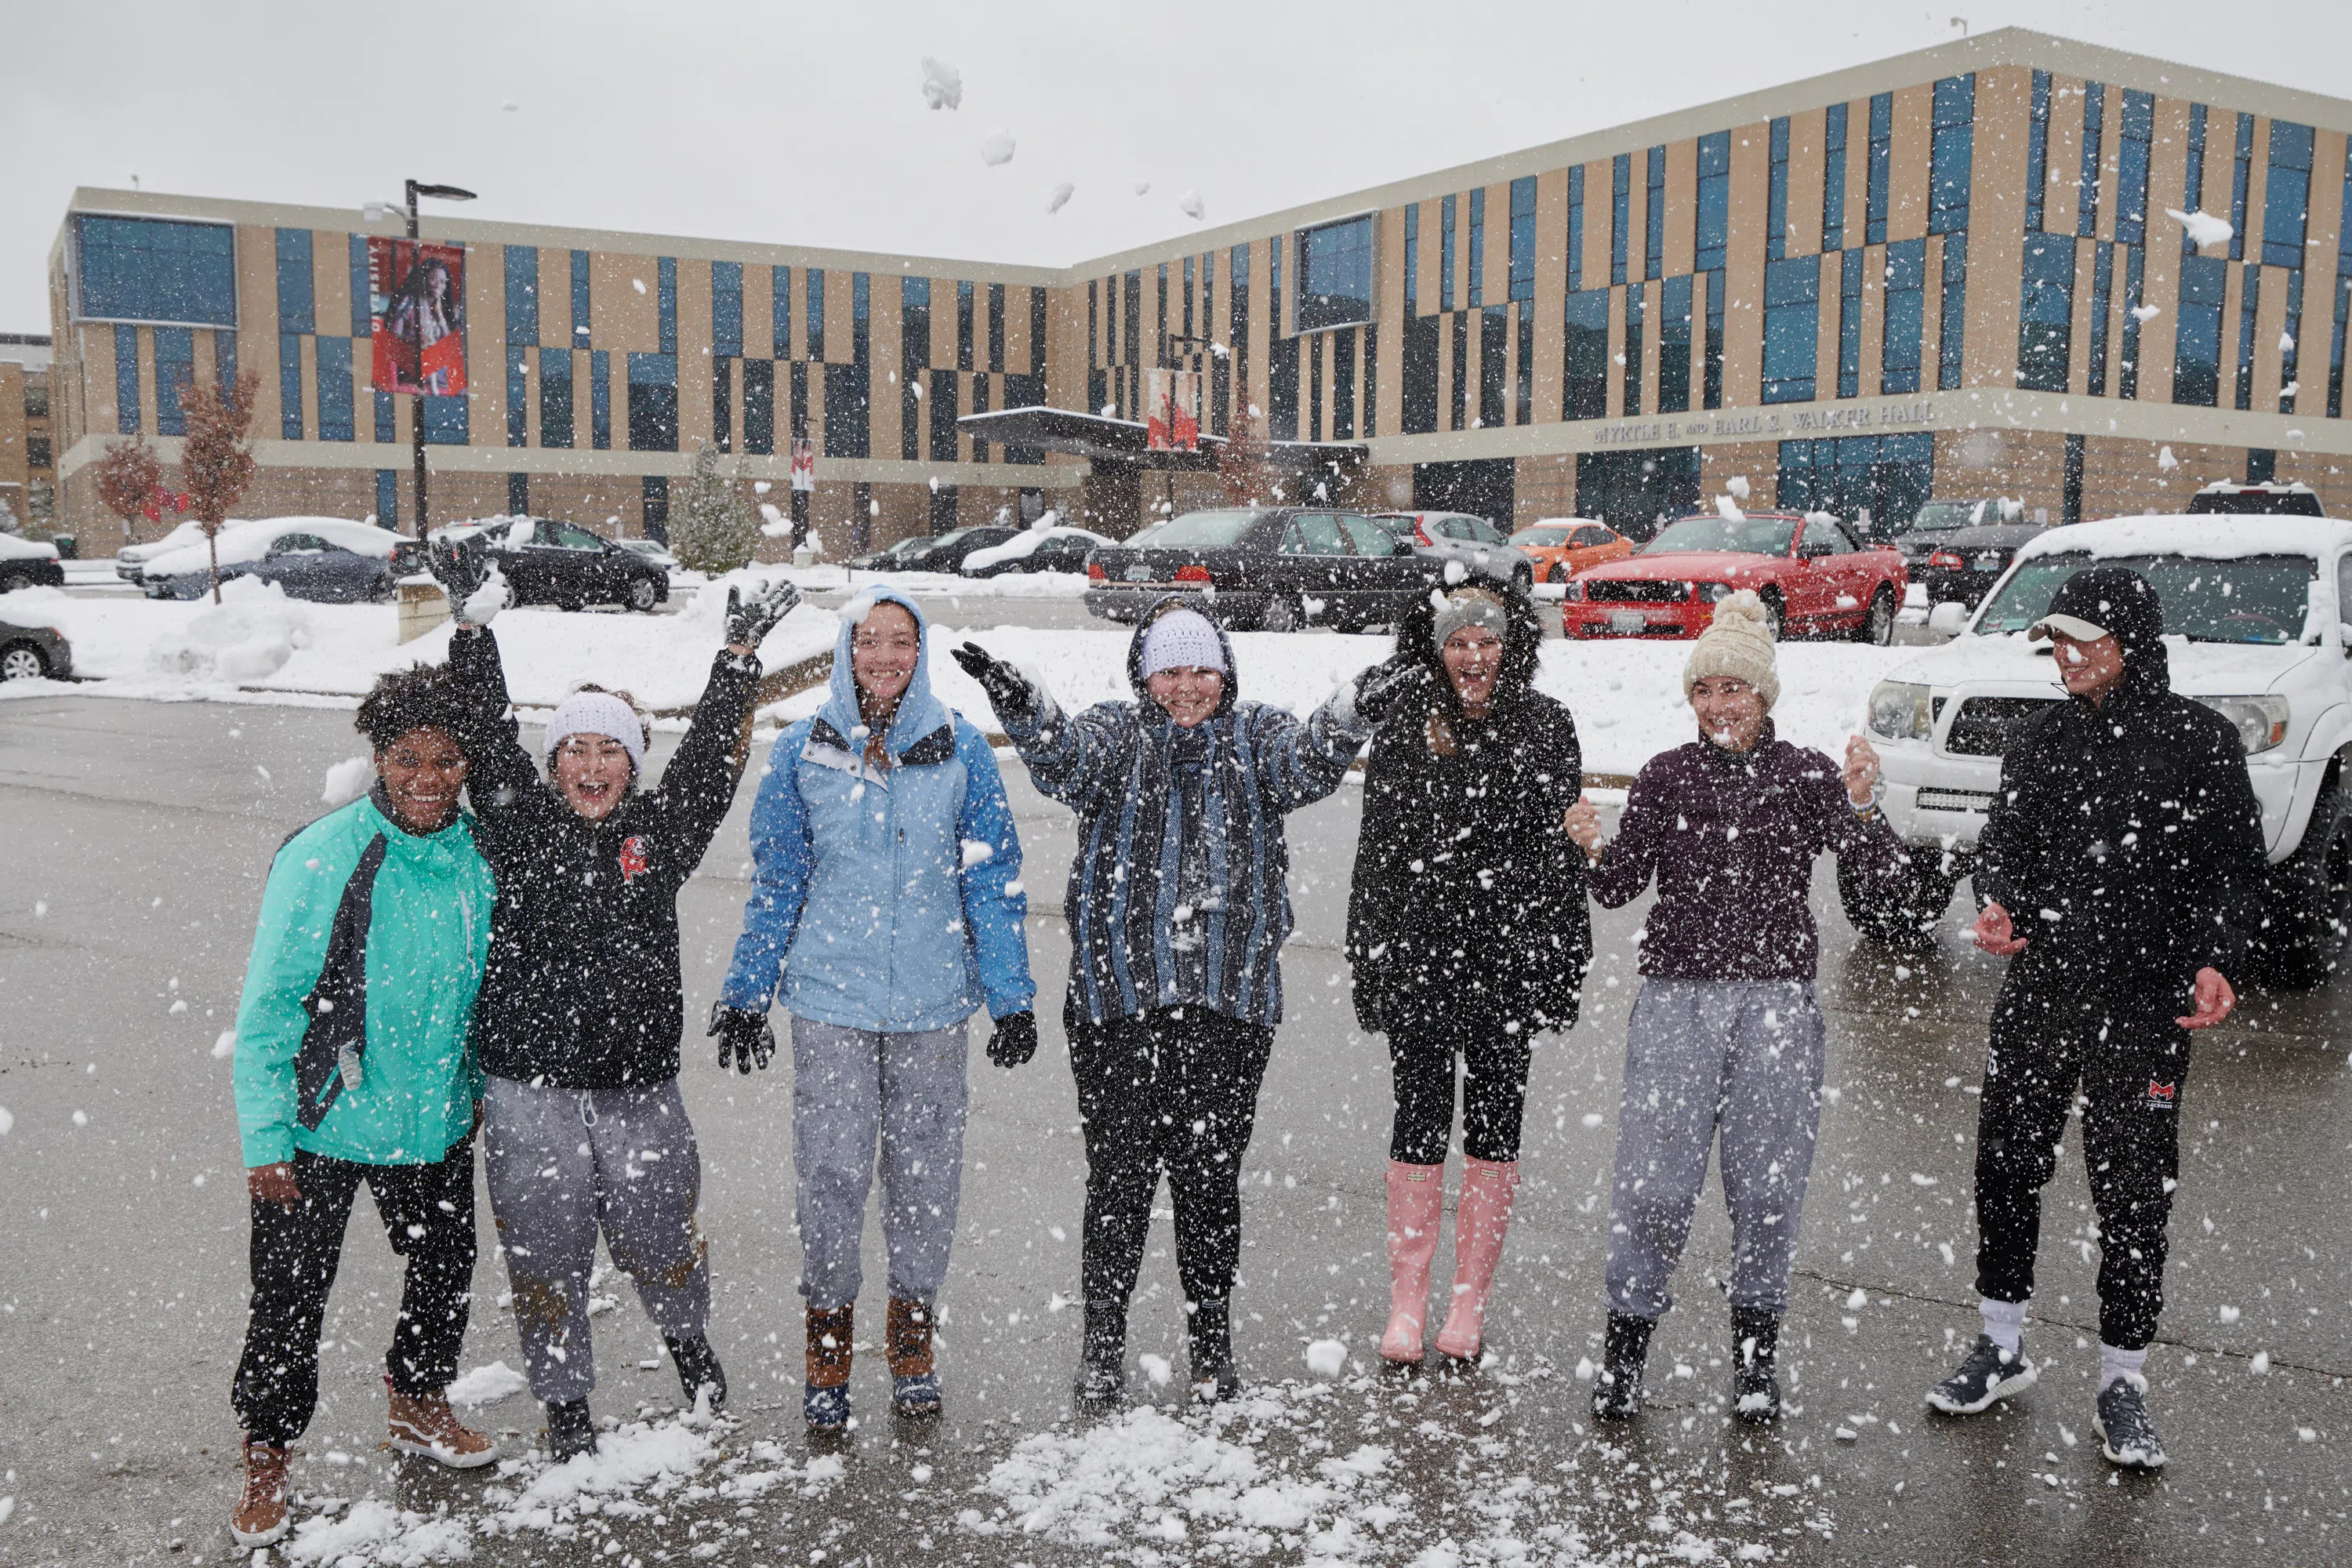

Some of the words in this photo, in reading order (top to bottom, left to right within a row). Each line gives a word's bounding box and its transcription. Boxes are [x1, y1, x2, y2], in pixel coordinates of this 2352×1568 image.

[368, 245, 382, 332] DIVERSITY
[1595, 424, 1661, 444] MYRTLE
[1667, 423, 1680, 440] E.
[1686, 423, 1707, 434] AND
[1713, 416, 1762, 436] EARL
[1769, 413, 1784, 432] E.
[1792, 407, 1871, 430] WALKER
[1878, 402, 1936, 424] HALL
[2149, 1079, 2175, 1101] M
